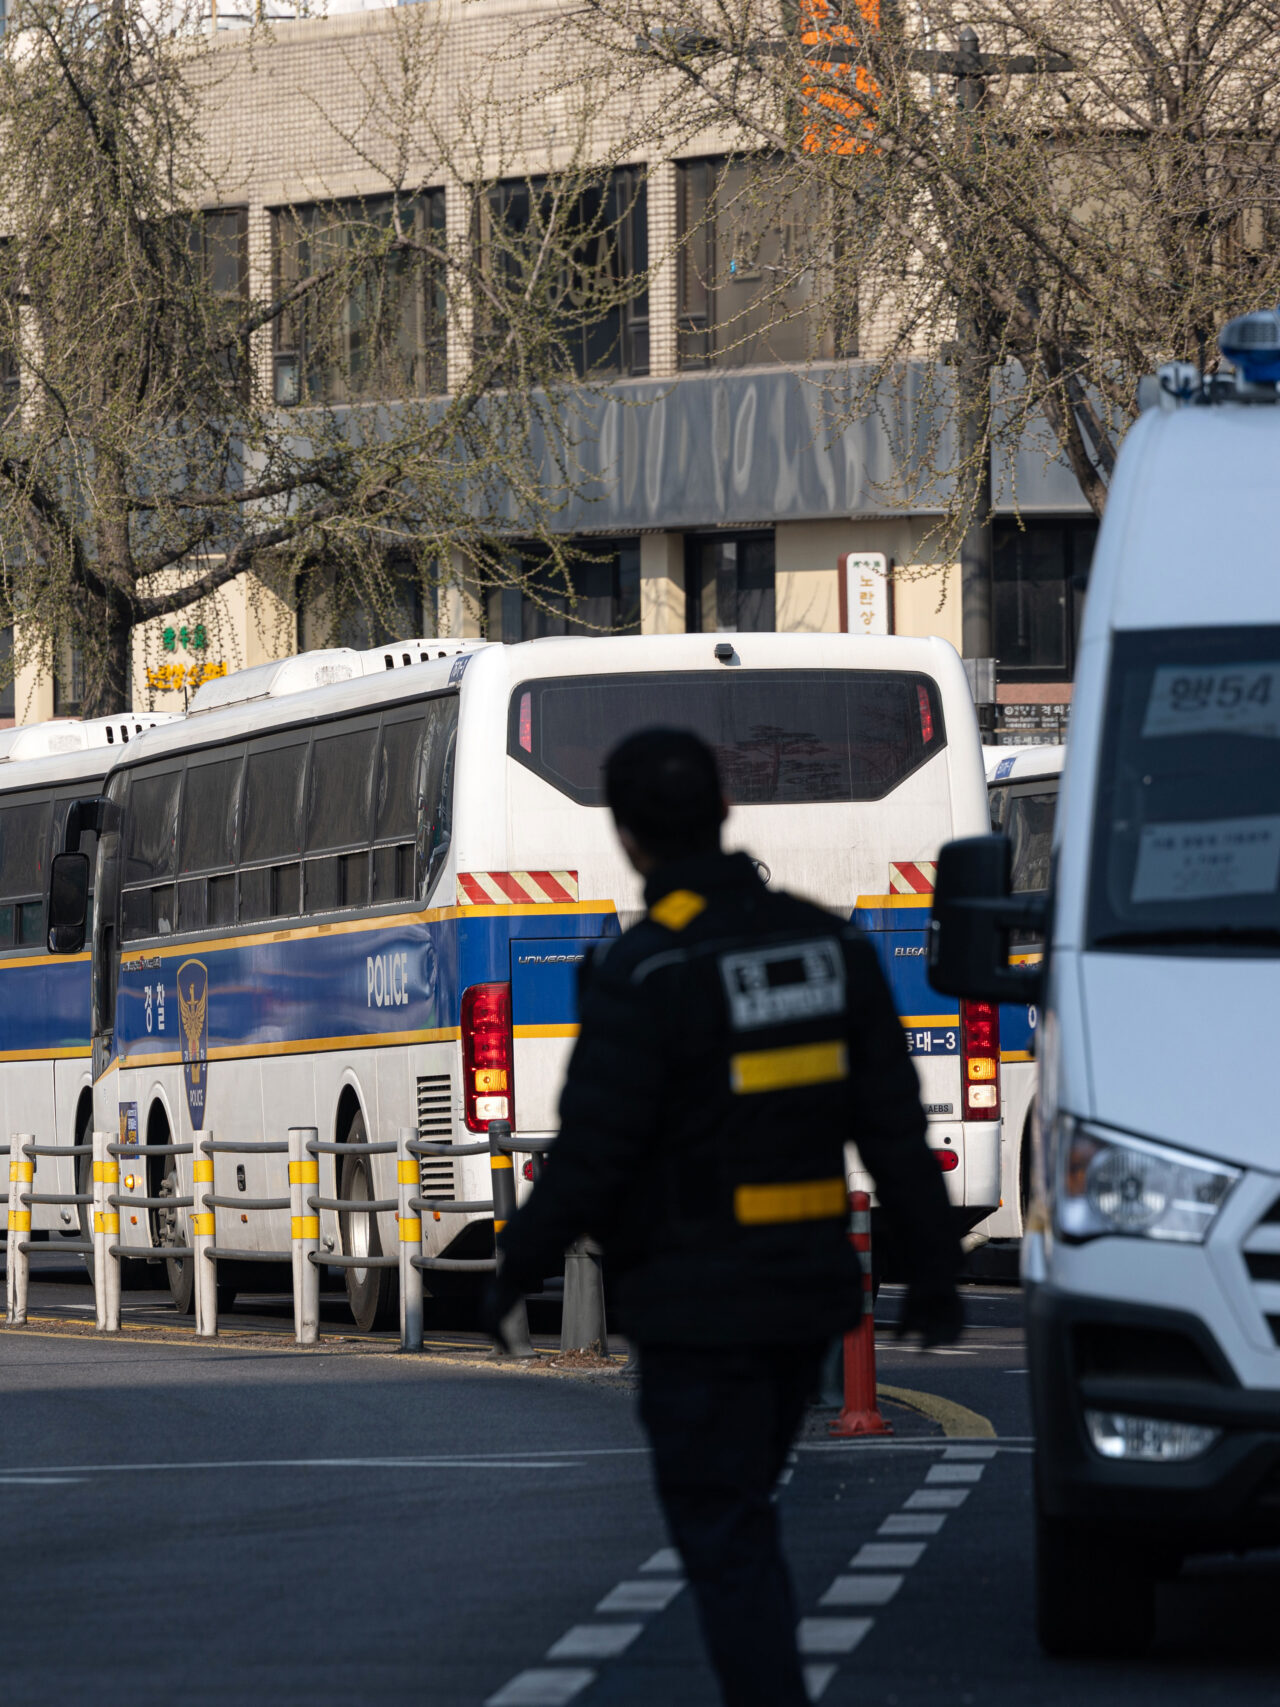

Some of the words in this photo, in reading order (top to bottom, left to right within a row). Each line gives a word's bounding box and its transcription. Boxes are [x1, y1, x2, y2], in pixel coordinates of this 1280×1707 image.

[894, 947, 928, 956] ELEGA
[366, 952, 409, 1008] POLICE
[143, 982, 166, 1033] 경찰
[190, 1089, 204, 1107] POLICE
[928, 1105, 949, 1113] AEBS
